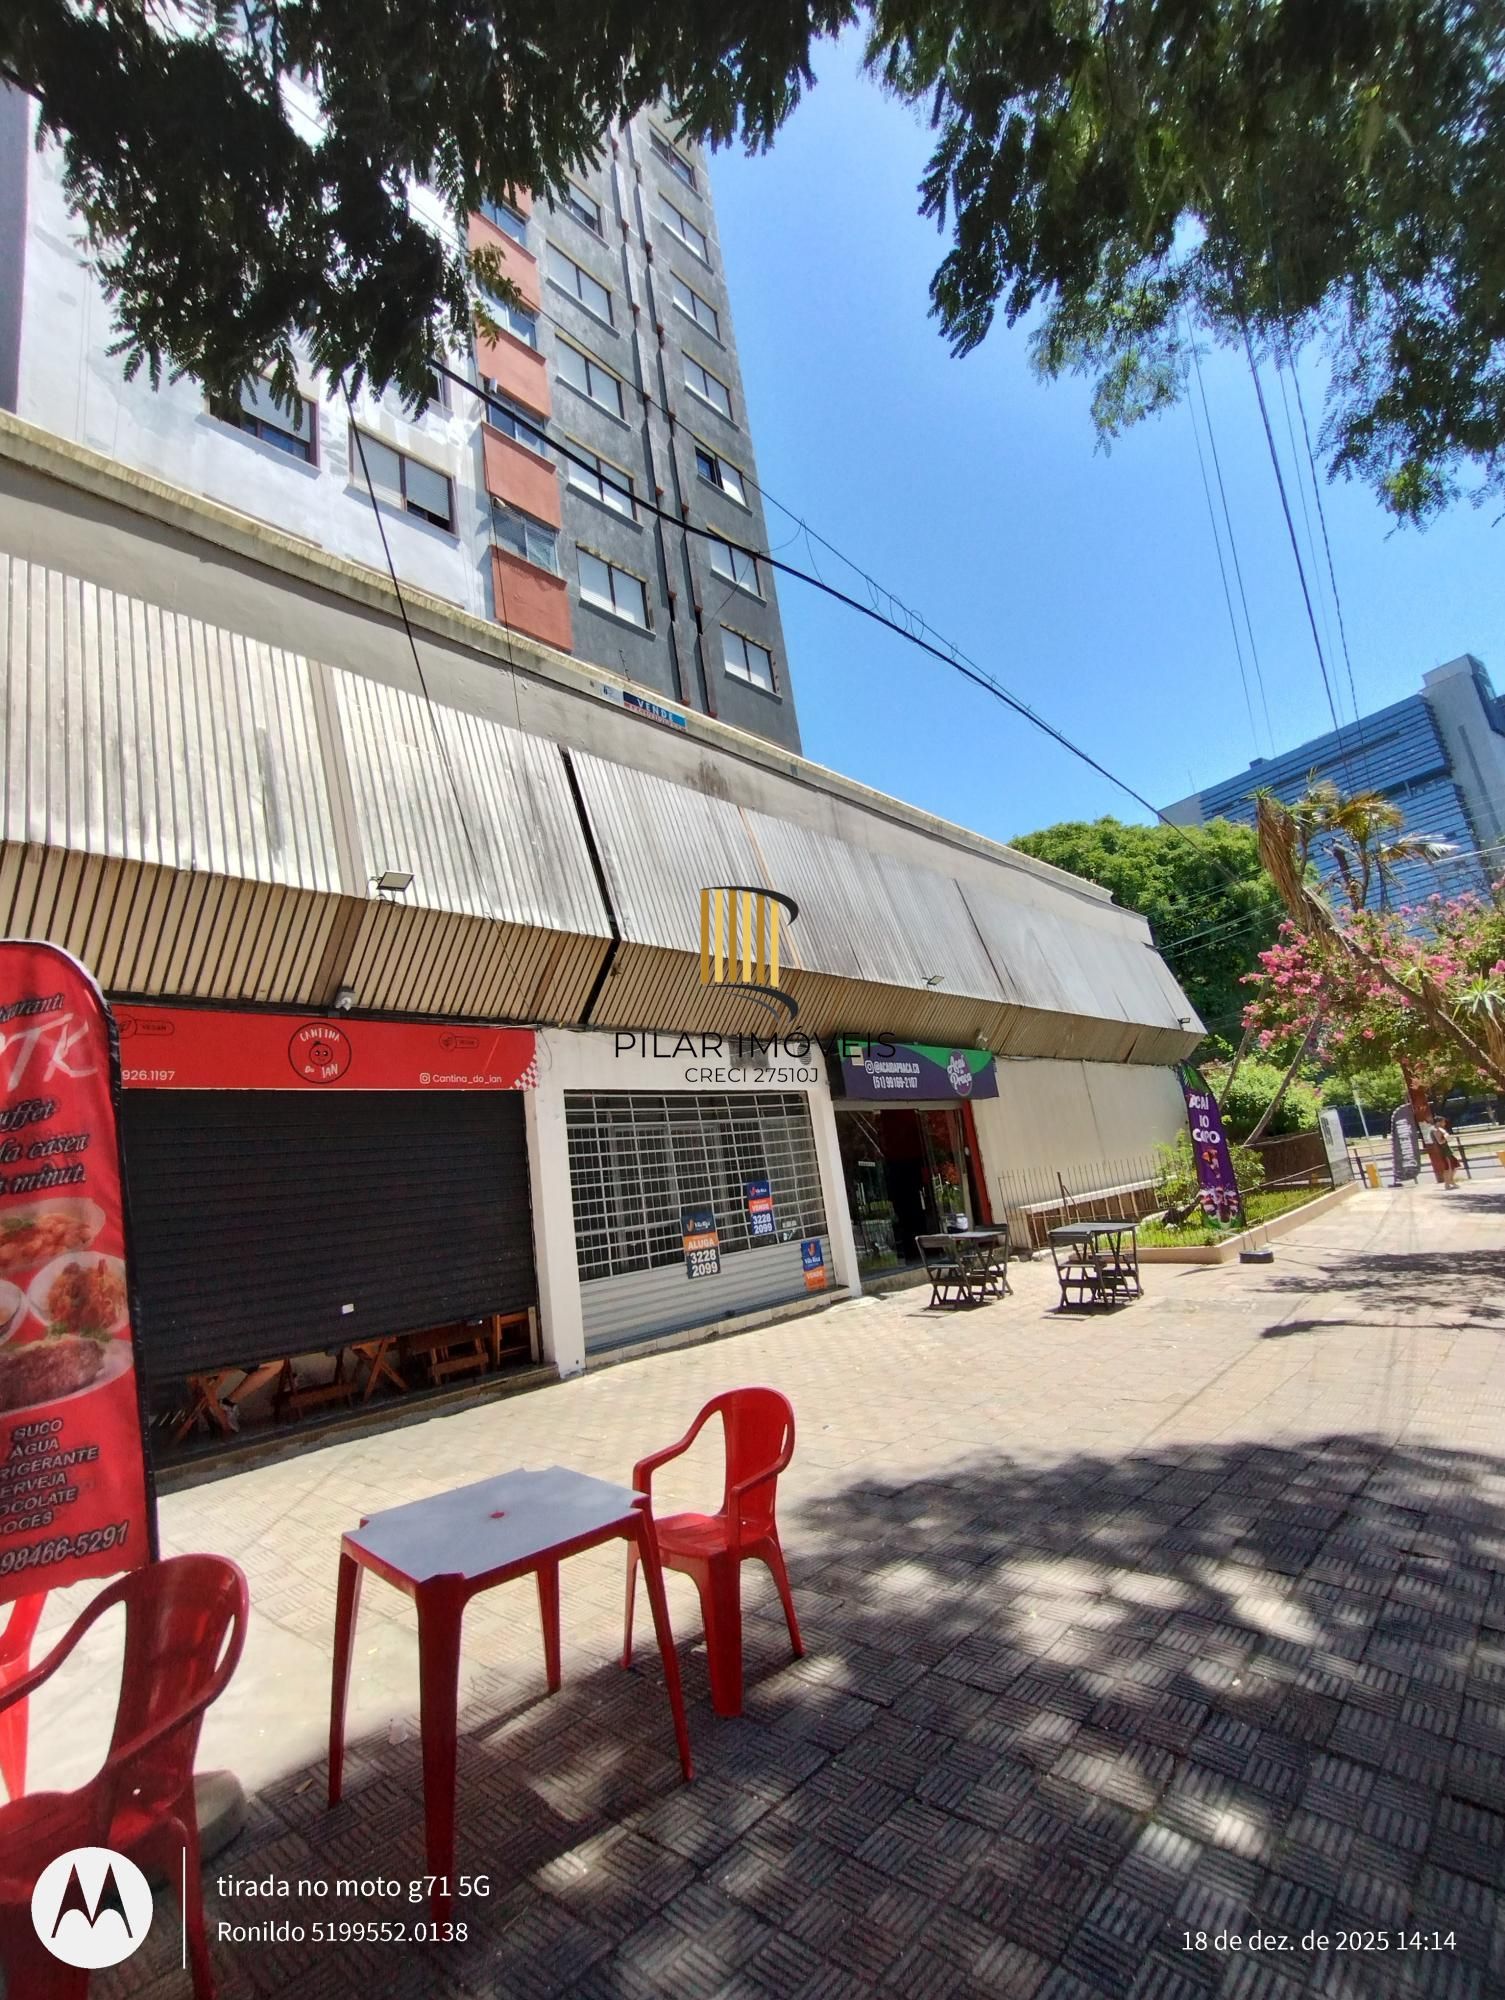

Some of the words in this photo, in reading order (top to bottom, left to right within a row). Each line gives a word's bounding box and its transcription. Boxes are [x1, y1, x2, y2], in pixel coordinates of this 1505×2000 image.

[636, 698, 674, 722] VENDE
[299, 1027, 340, 1043] CANTINA
[0, 1012, 97, 1092] TK
[122, 1069, 176, 1081] 926.1197
[321, 1063, 339, 1079] IAN
[0, 1099, 56, 1132] uffet
[12, 1163, 86, 1194] minut
[752, 1213, 771, 1225] 3228
[753, 1223, 773, 1235] 2099
[688, 1237, 715, 1250] ALUGA
[690, 1249, 716, 1264] 3228
[692, 1261, 718, 1277] 2099
[13, 1419, 62, 1441] SUCO
[0, 1447, 98, 1480] RIGERANTE
[0, 1472, 67, 1497] ERVEJA
[0, 1488, 77, 1517] OCOLATE
[0, 1511, 53, 1535] OCES
[0, 1520, 128, 1575] 98466-5291
